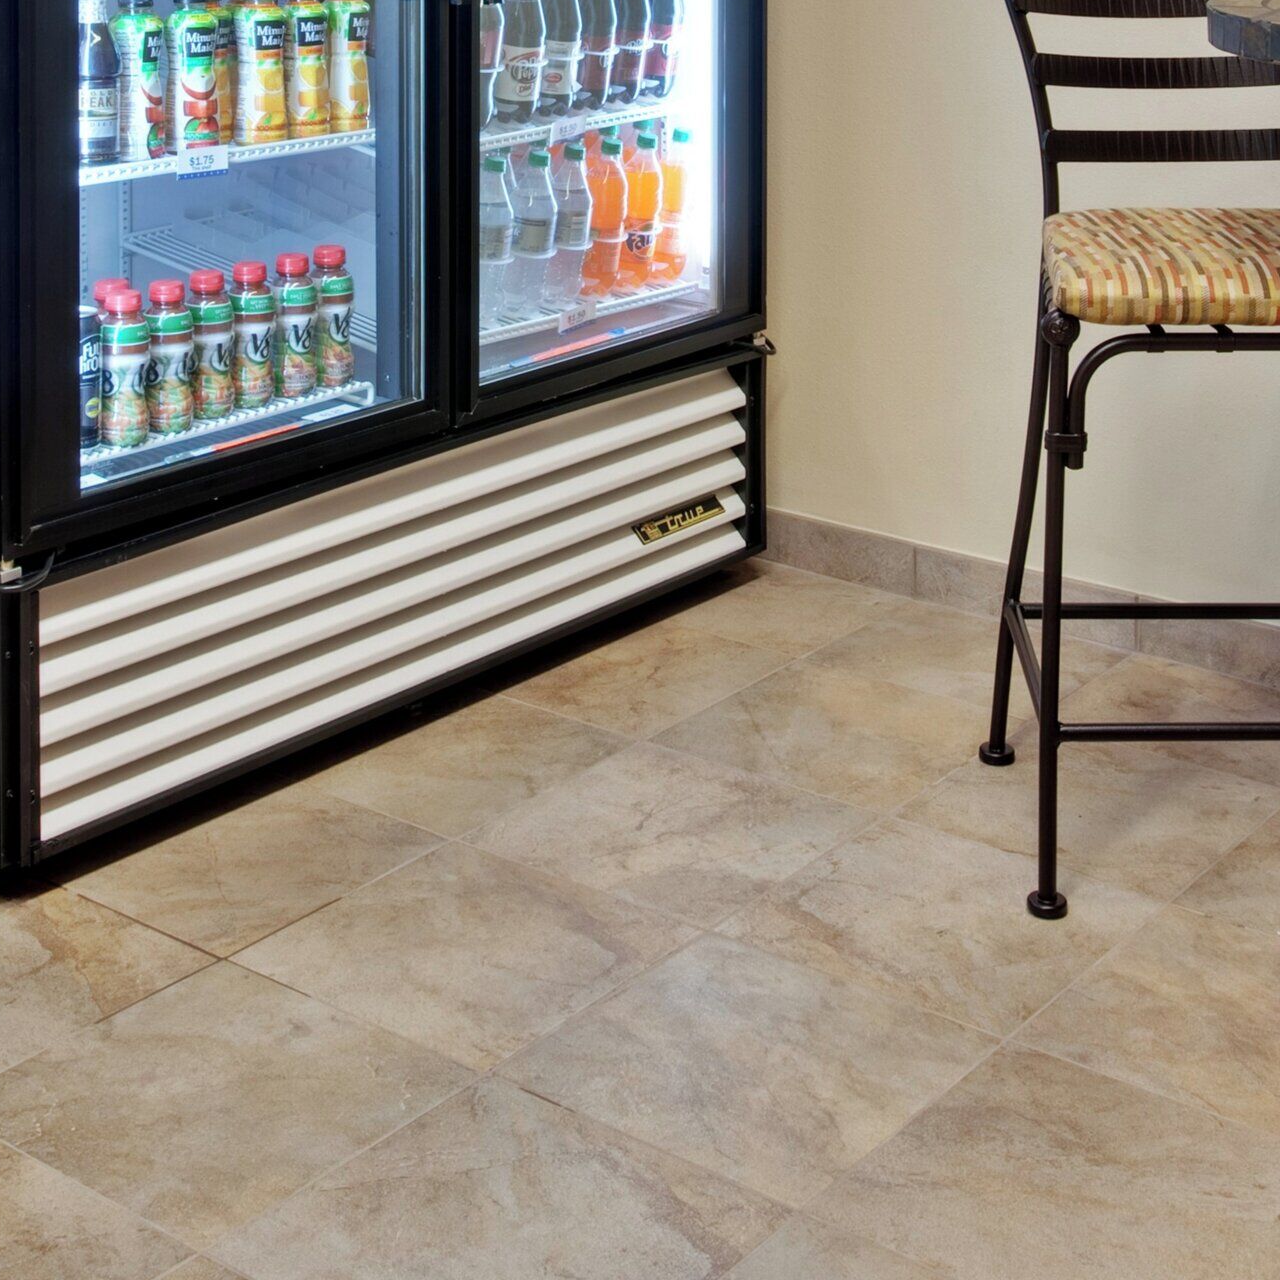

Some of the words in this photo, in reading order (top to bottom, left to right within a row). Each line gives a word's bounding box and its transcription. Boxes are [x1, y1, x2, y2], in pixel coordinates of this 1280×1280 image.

[189, 155, 215, 167] $1.75
[626, 231, 654, 252] Fan
[251, 326, 271, 359] V8
[292, 317, 312, 350] V8
